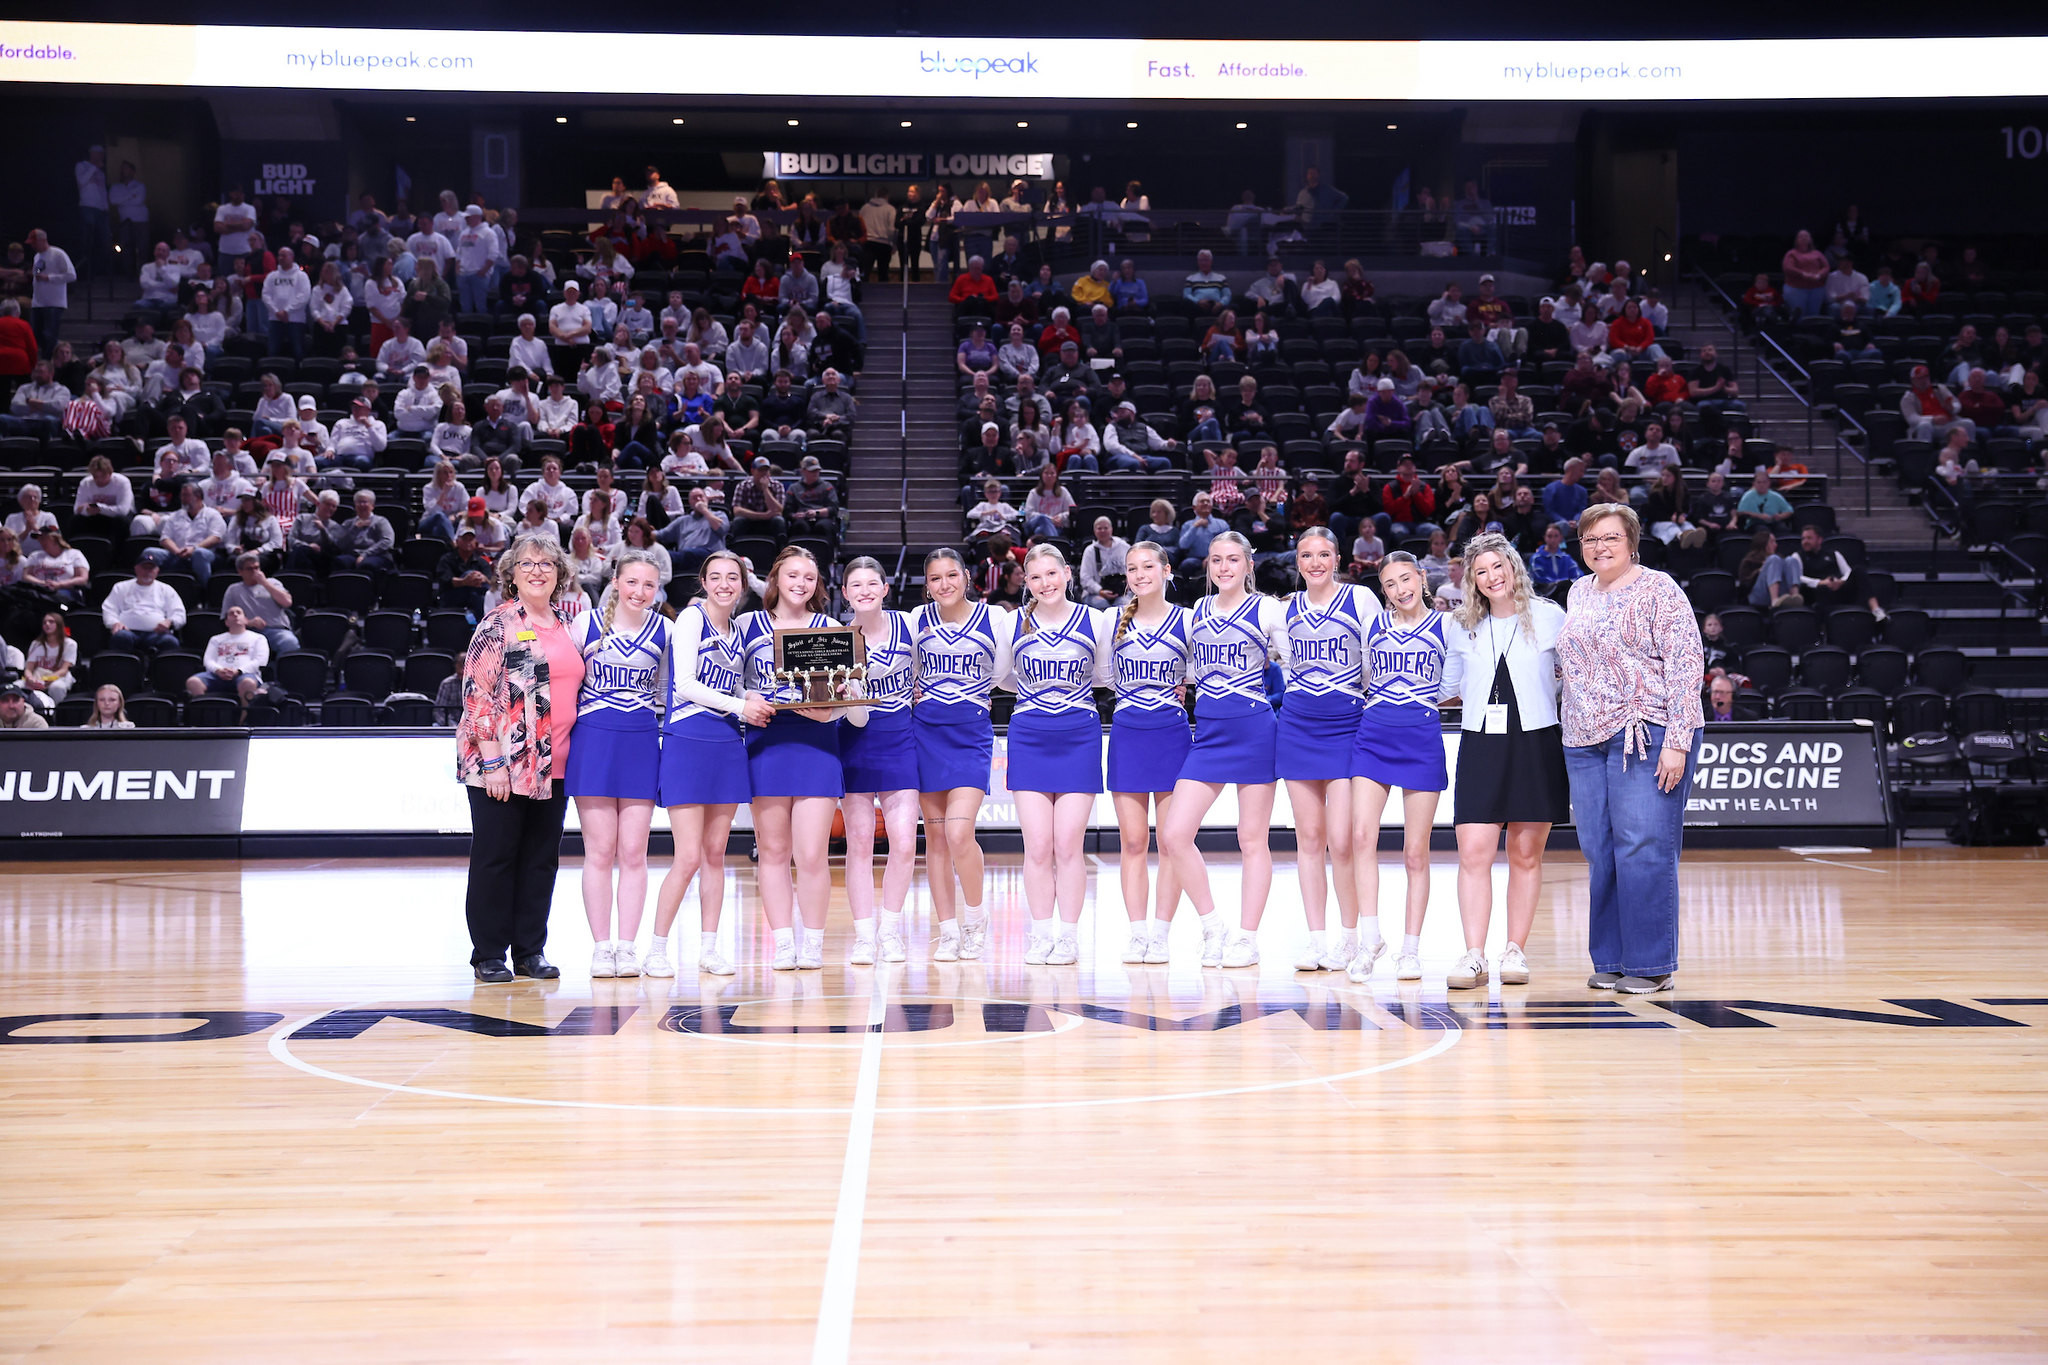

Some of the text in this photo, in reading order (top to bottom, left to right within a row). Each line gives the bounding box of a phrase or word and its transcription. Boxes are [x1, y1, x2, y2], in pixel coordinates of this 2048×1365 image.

[287, 48, 472, 72] mybluepeak.com
[920, 50, 1038, 80] bluepeak
[1149, 61, 1308, 78] Fast. Affordable.
[1504, 62, 1681, 83] mybluepeak.com
[2000, 125, 2048, 159] 10
[262, 163, 307, 179] BUD
[780, 152, 1044, 175] BUD LIGHT LOUNGE
[254, 179, 316, 195] LIGHT
[919, 645, 984, 680] RAIDERS
[1193, 638, 1248, 671] RAIDERS
[1289, 632, 1349, 667] RAIDERS
[1022, 652, 1088, 686] RAIDERS
[1116, 651, 1179, 685] RAIDERS
[1371, 647, 1438, 683] RAIDERS
[1775, 743, 1843, 764] AND
[1734, 798, 1818, 811] HEALTH
